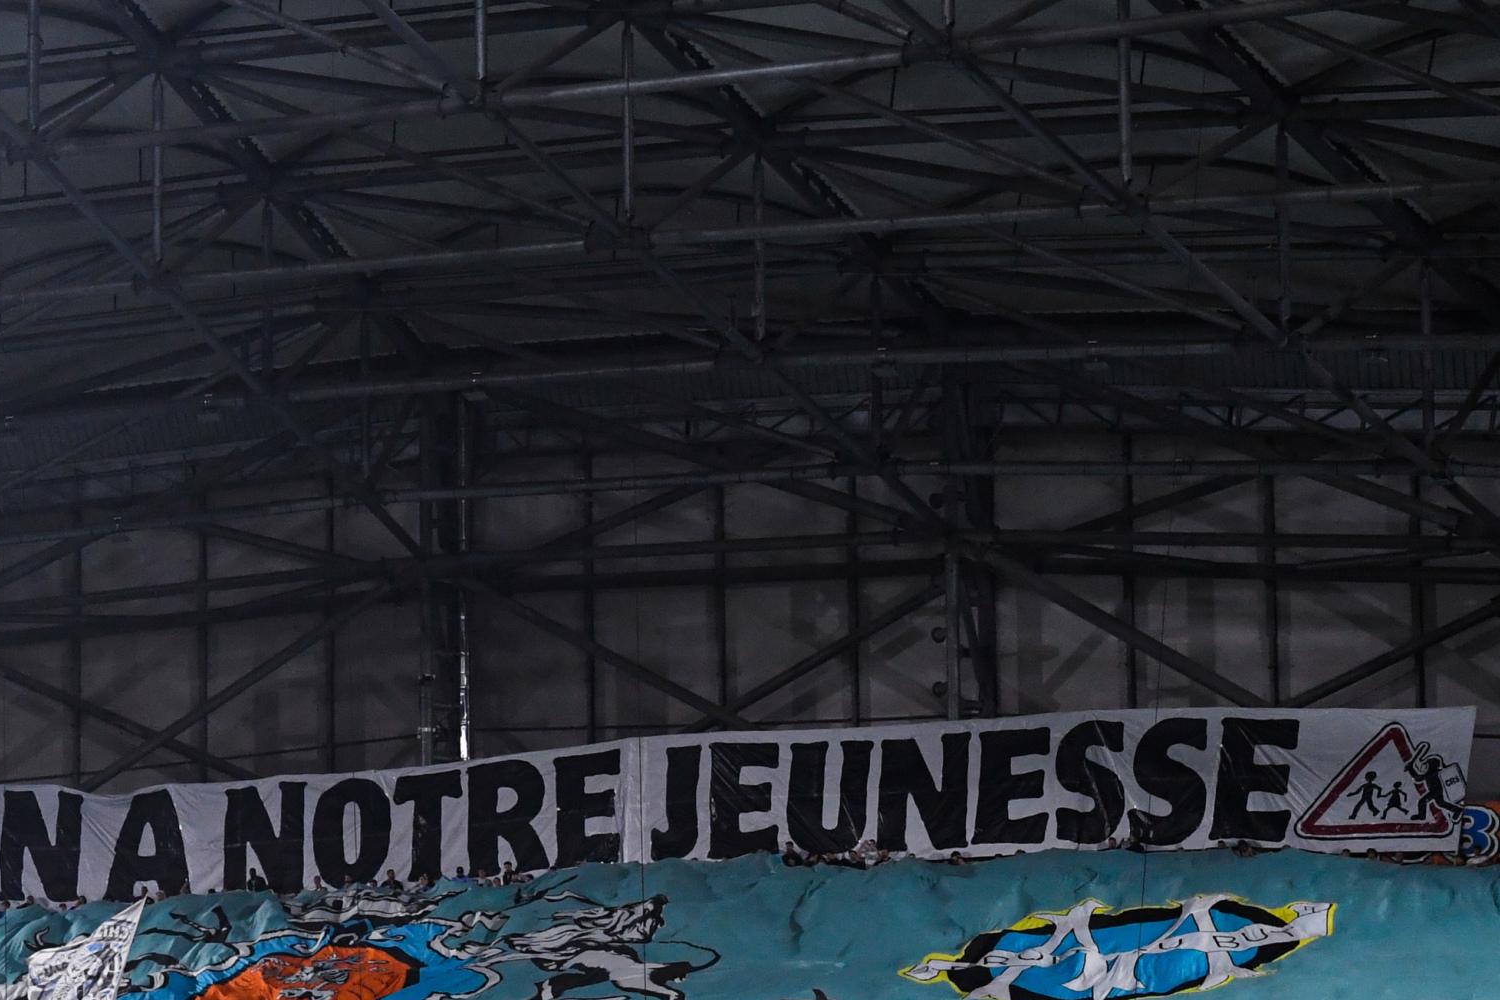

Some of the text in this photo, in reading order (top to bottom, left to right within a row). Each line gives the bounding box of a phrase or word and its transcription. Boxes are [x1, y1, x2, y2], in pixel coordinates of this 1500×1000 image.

[105, 799, 186, 902] A
[223, 748, 622, 897] NOTRE
[650, 715, 1302, 862] JEUNESSE
